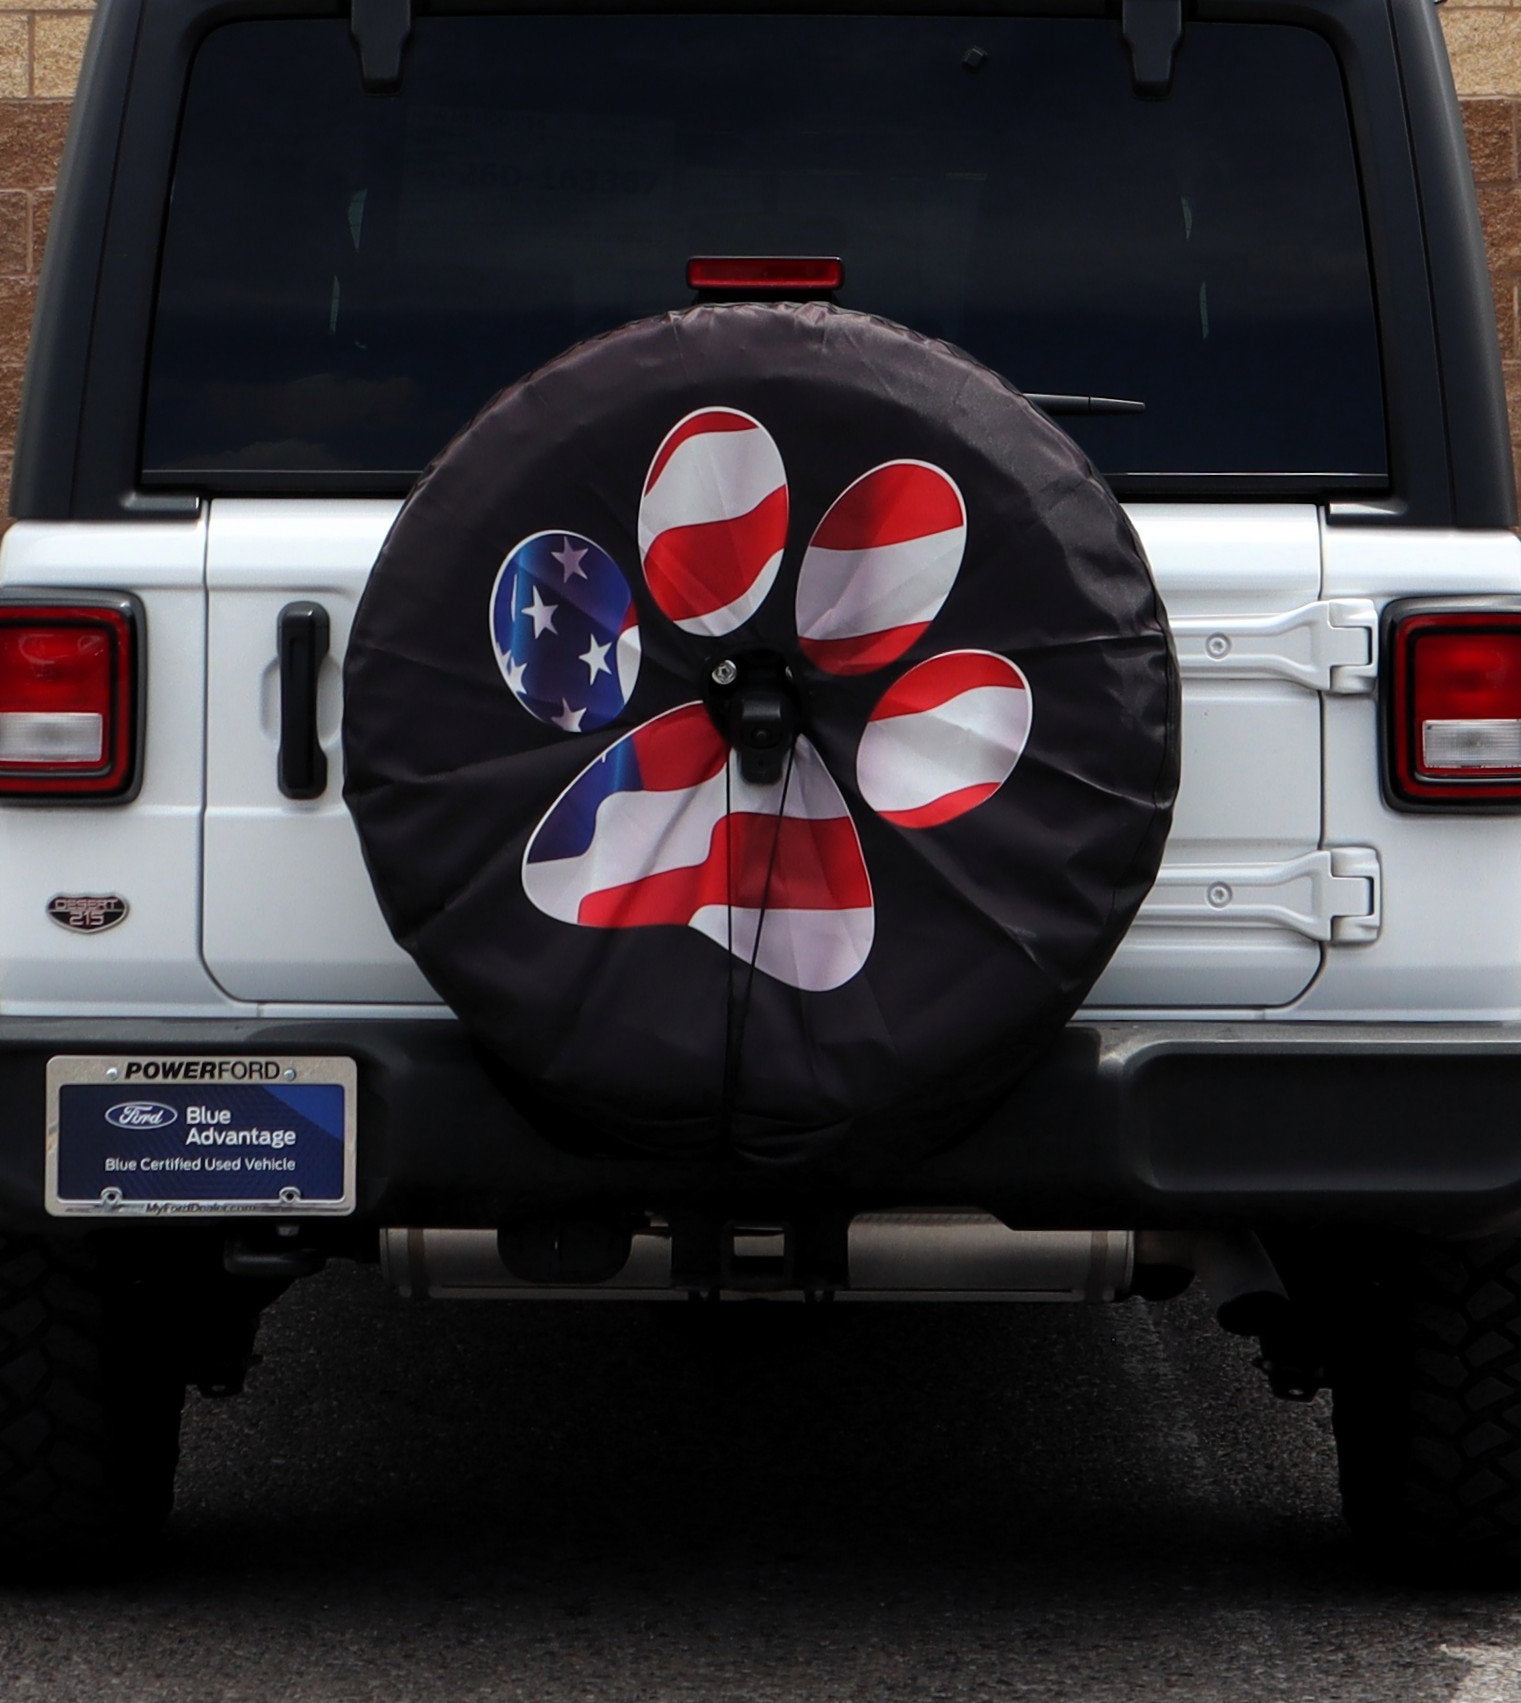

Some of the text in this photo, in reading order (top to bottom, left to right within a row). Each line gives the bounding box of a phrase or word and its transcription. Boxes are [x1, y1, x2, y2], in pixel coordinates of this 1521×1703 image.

[69, 910, 105, 925] 215
[124, 1061, 280, 1080] POWERFORD
[118, 1105, 164, 1125] Ford
[186, 1105, 231, 1125] Blue
[185, 1127, 296, 1149] Advantage
[105, 1157, 296, 1172] Blue Certified Used Vehicle
